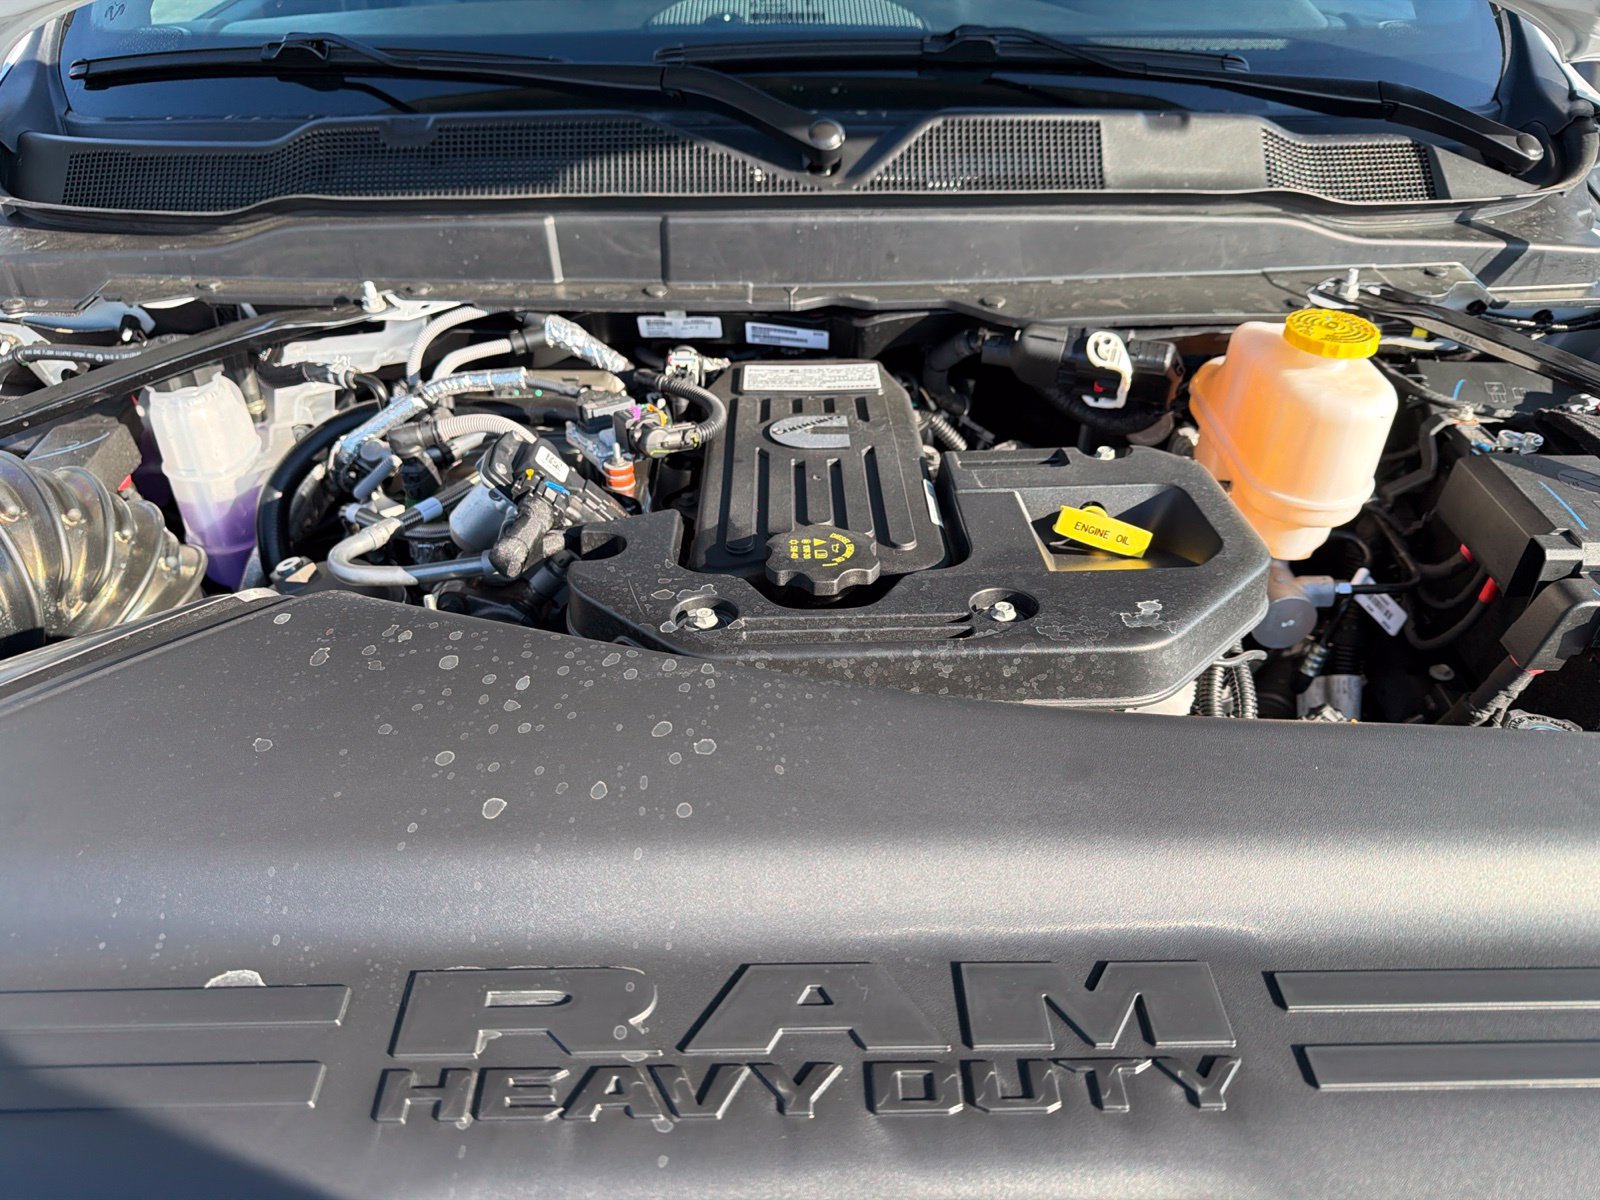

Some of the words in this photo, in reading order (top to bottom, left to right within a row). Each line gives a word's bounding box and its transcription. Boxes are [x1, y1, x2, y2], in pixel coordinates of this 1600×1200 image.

[1073, 521, 1110, 539] ENGINE
[1115, 534, 1130, 546] OIL
[386, 960, 1238, 1058] RAM
[371, 1061, 843, 1124] HEAVY
[862, 1055, 1242, 1117] DUTY
